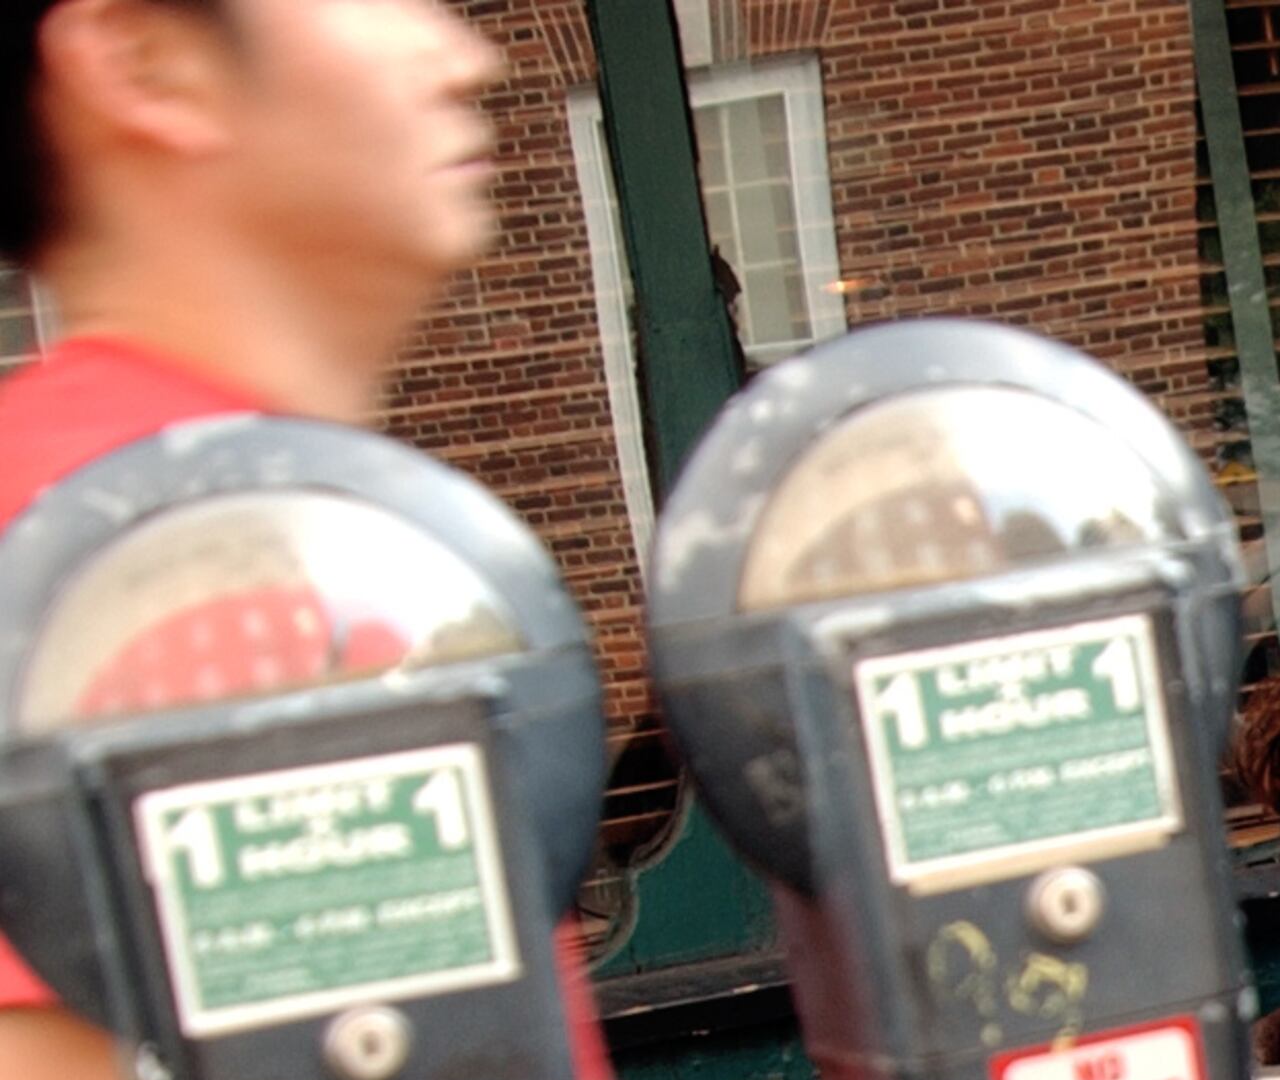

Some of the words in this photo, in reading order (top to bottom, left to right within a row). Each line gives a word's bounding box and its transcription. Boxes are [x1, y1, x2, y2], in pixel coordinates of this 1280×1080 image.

[876, 671, 926, 748] 1
[938, 649, 1074, 695] LIMIT
[1092, 636, 1140, 712] 1
[942, 691, 1088, 738] HOUR
[166, 805, 224, 887] 1
[412, 767, 469, 850] 1
[239, 826, 408, 878] HOUR
